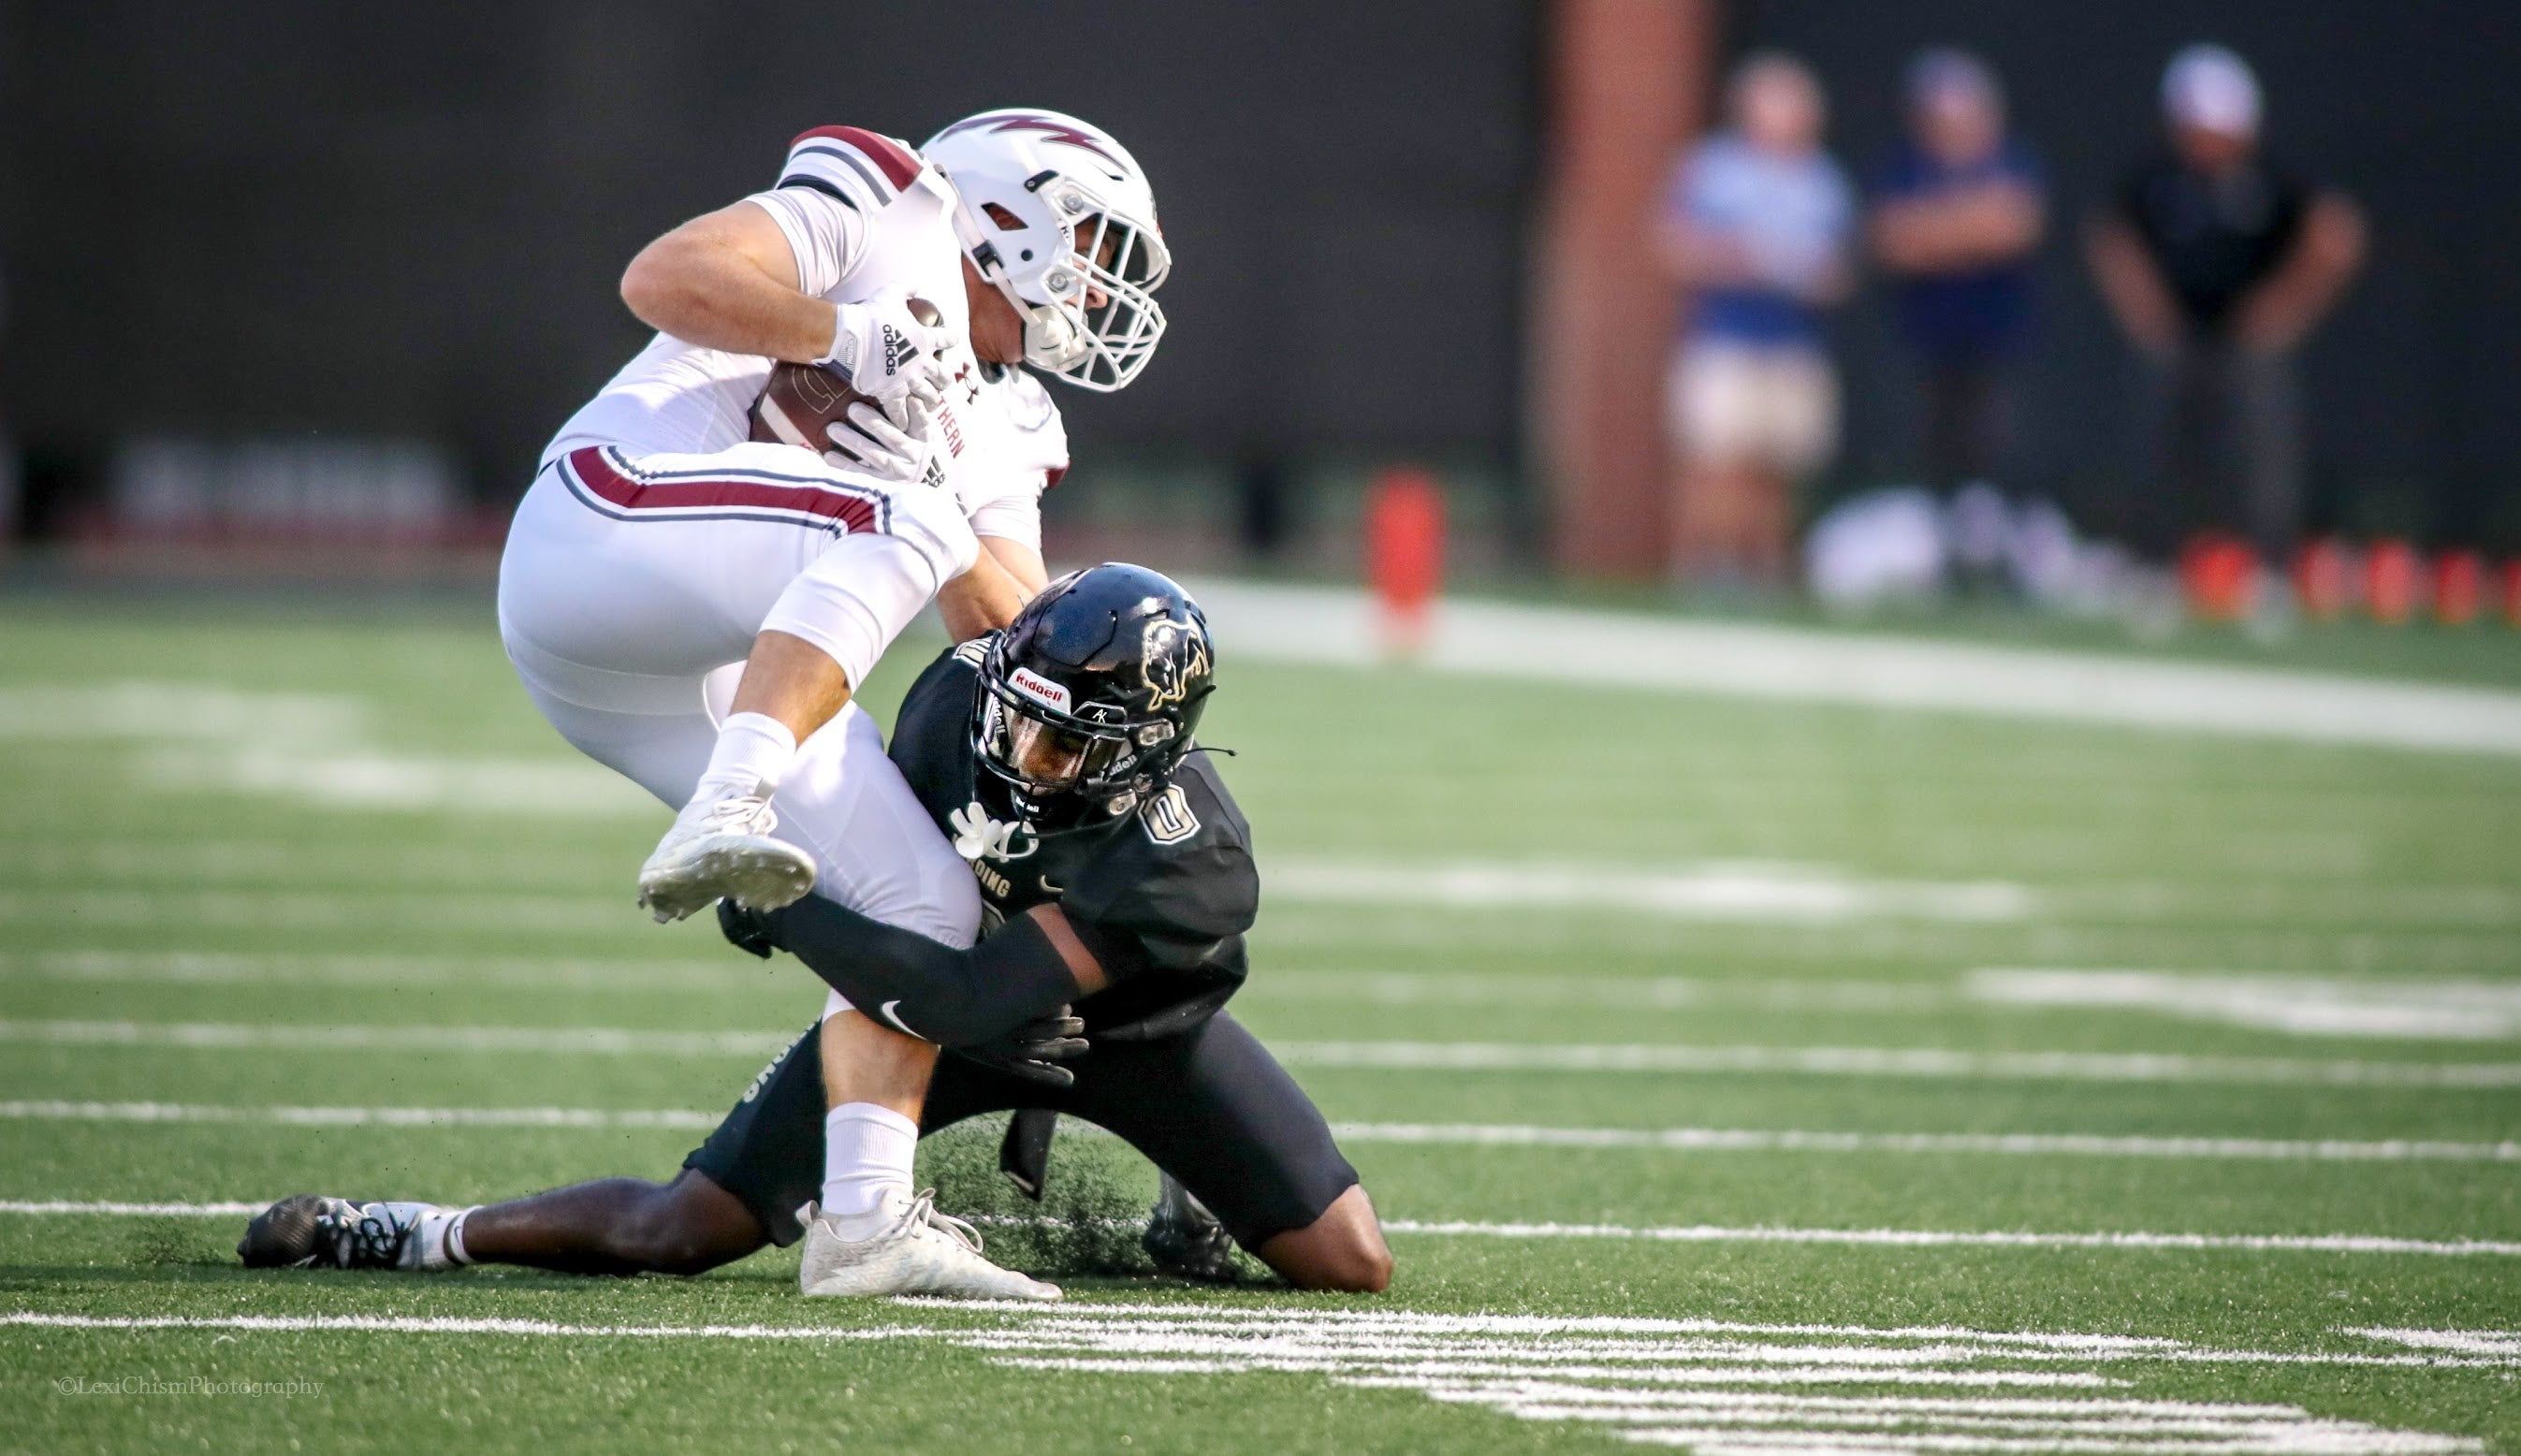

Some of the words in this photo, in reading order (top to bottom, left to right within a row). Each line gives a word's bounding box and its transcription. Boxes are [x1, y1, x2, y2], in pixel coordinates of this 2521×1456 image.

[882, 324, 898, 376] adidas
[937, 395, 965, 459] THERN
[1015, 673, 1063, 703] Riddell
[968, 858, 1012, 897] DING
